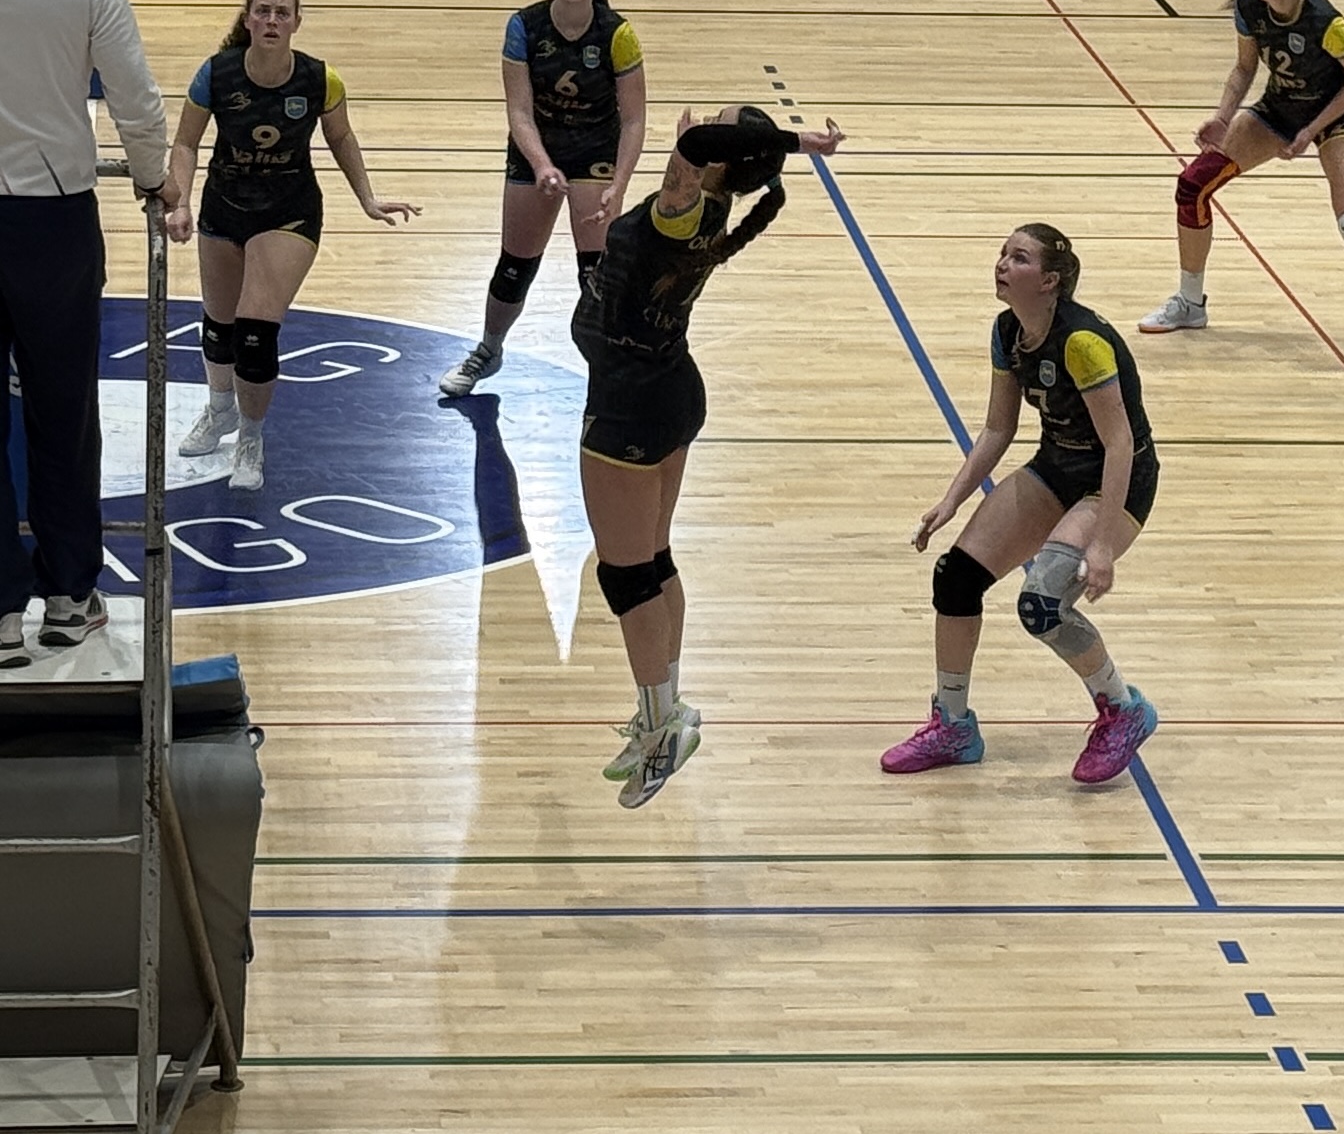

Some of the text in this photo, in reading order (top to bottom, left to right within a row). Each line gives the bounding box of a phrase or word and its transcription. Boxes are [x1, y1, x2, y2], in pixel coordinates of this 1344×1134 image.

[1261, 46, 1296, 78] 12
[554, 70, 579, 97] 6
[251, 124, 282, 150] 9
